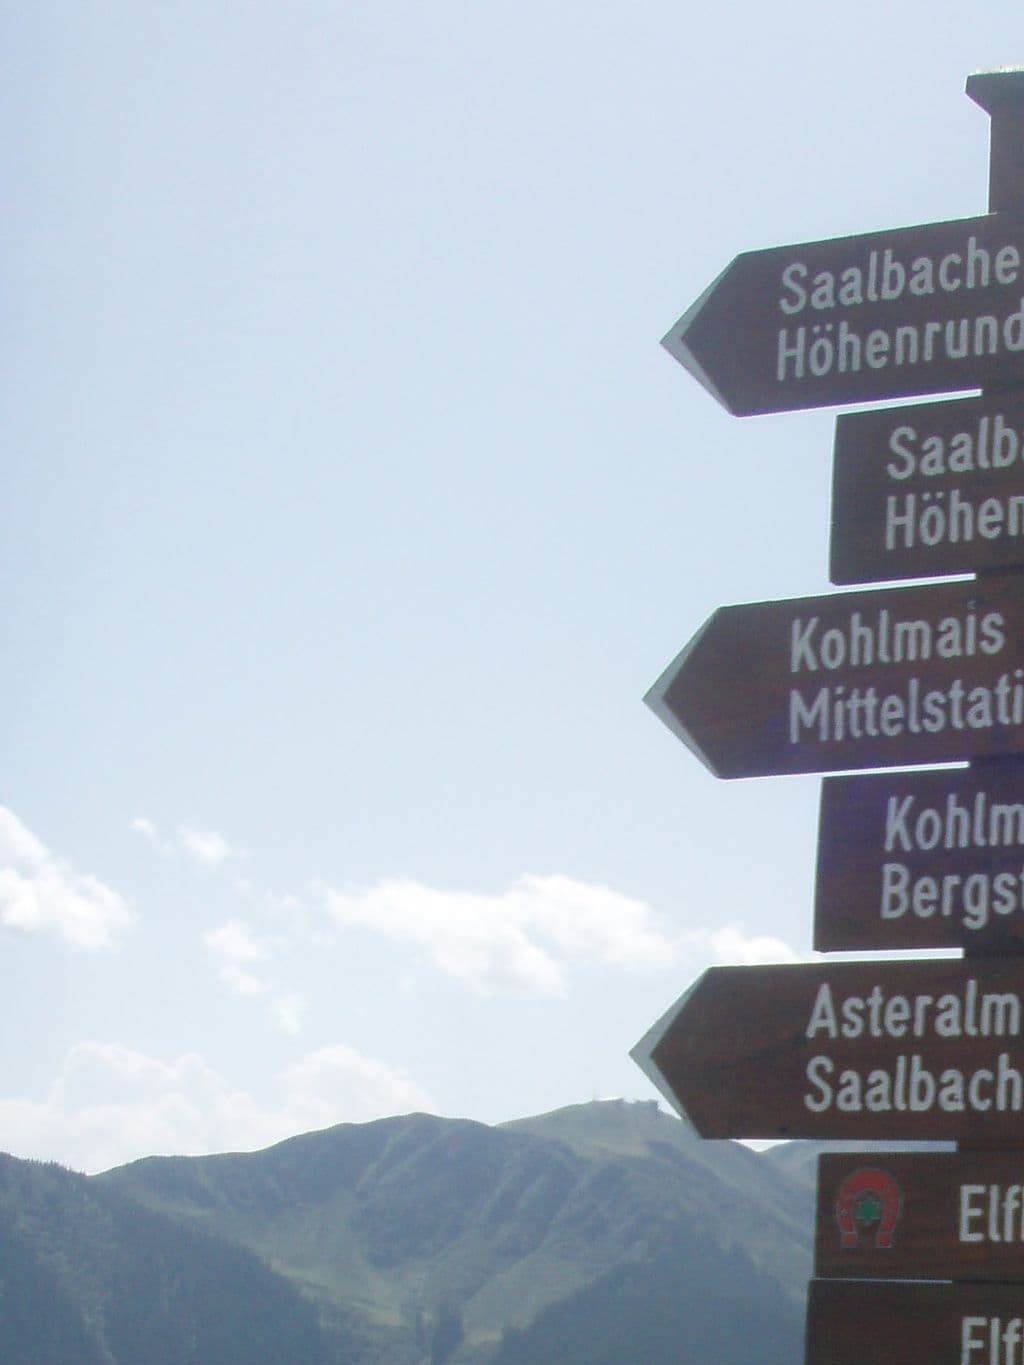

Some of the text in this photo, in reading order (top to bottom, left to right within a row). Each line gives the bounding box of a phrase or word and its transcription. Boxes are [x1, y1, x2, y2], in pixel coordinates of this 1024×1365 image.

[789, 602, 1005, 673] Kohlmais
[806, 980, 1020, 1039] Asteralm
[804, 1053, 1022, 1113] Saalbach
